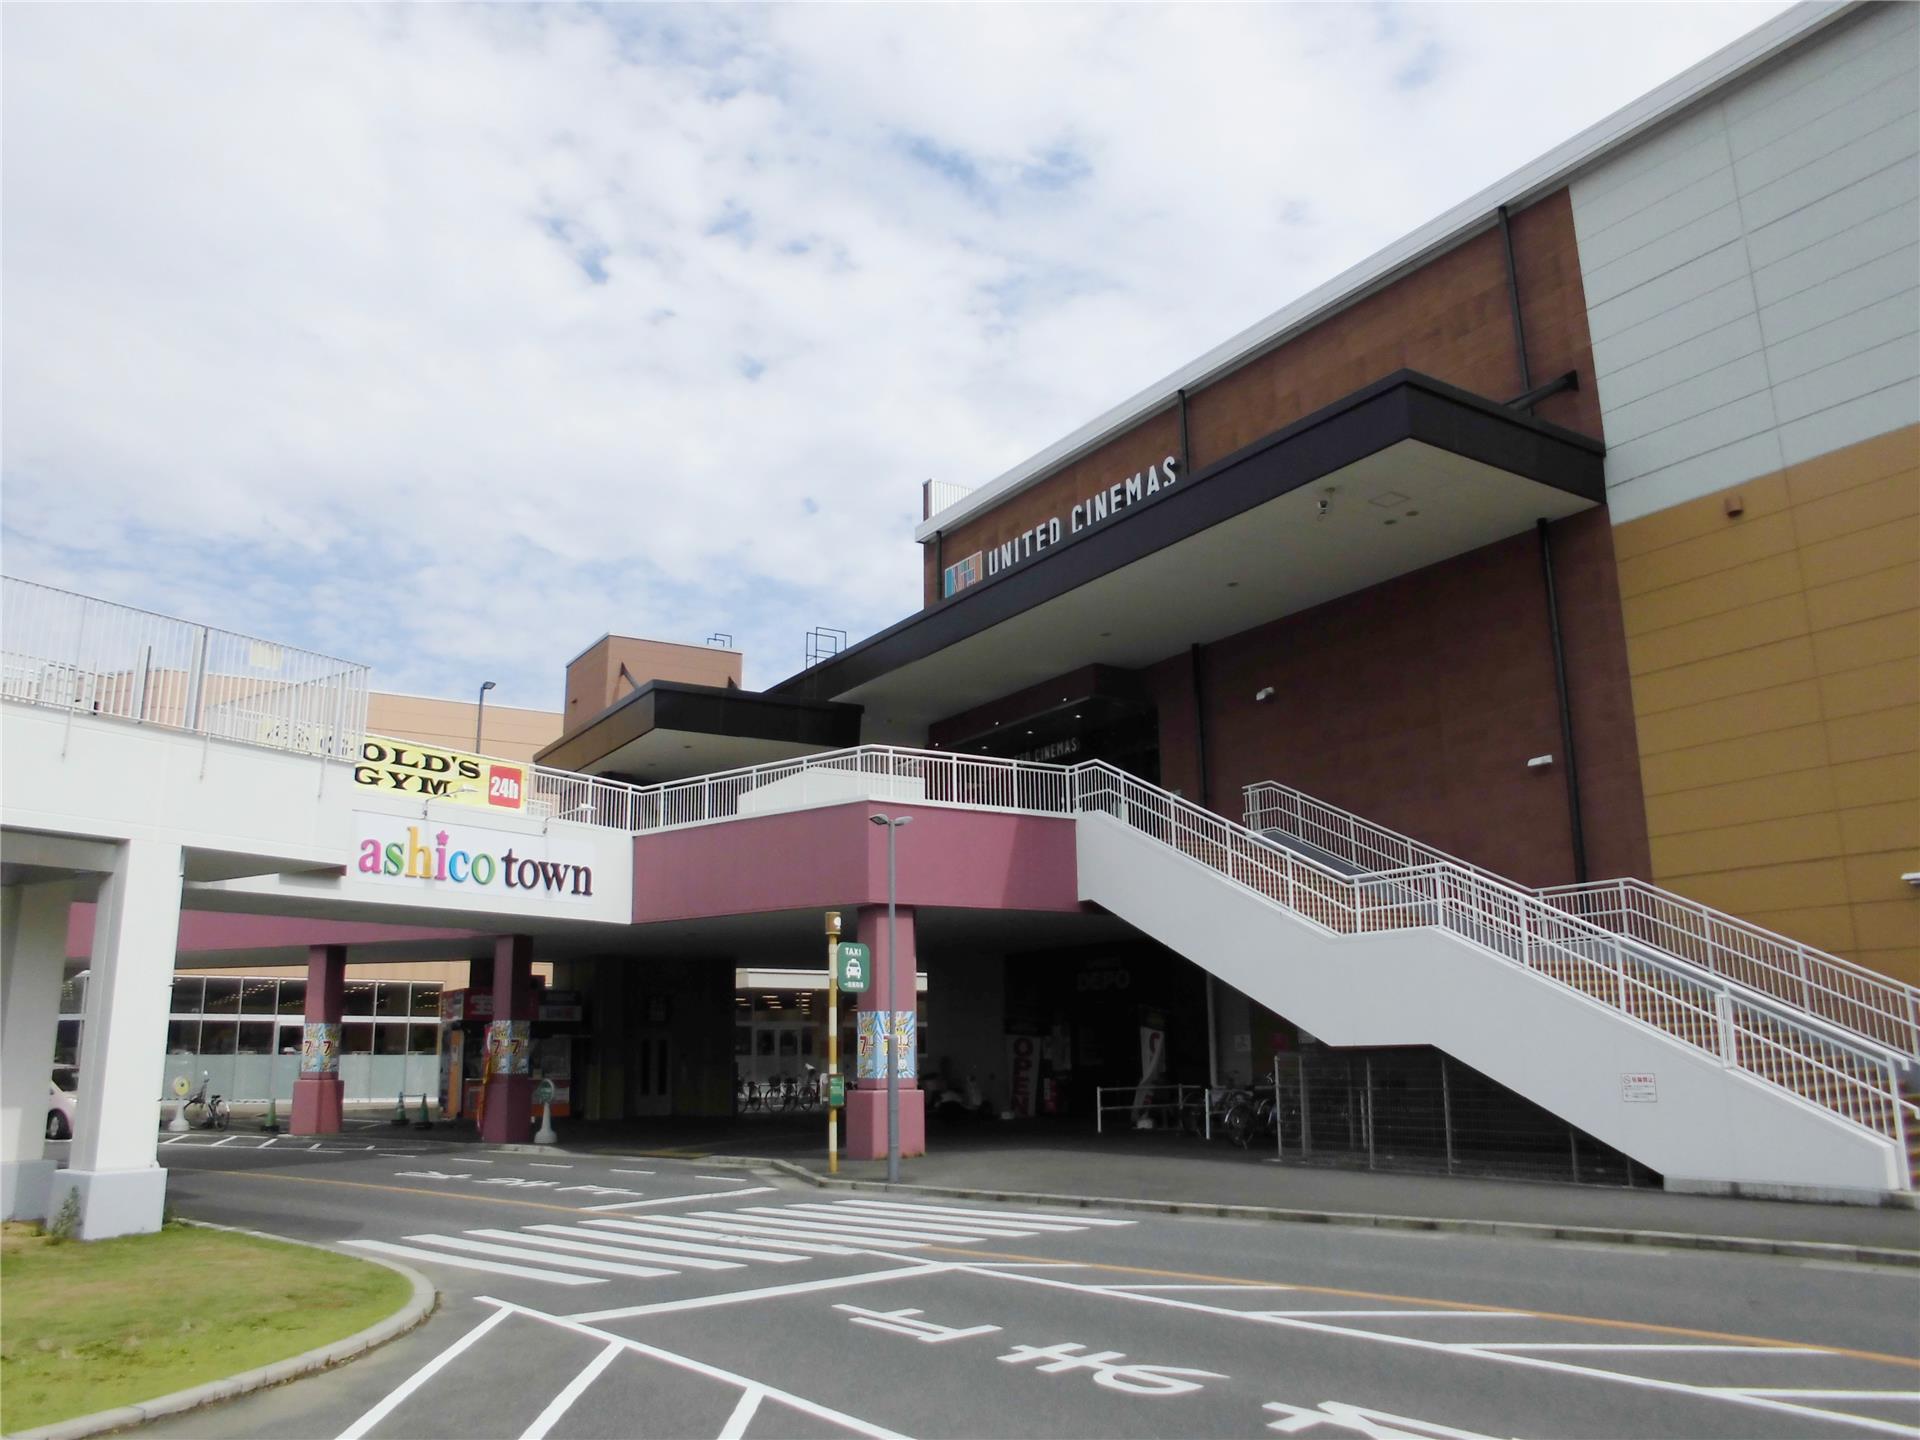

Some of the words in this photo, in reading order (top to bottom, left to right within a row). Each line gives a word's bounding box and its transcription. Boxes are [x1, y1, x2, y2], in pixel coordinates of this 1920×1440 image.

[988, 517, 1060, 575] UNITED
[1071, 455, 1177, 534] CINEMAS
[362, 742, 481, 779] OLD'S
[354, 765, 452, 798] GYM
[490, 776, 519, 801] 24h
[358, 826, 496, 886] ashico
[501, 848, 593, 897] town
[844, 946, 862, 956] TAXI
[1076, 968, 1131, 992] DEPO
[1010, 1037, 1034, 1120] OPEN
